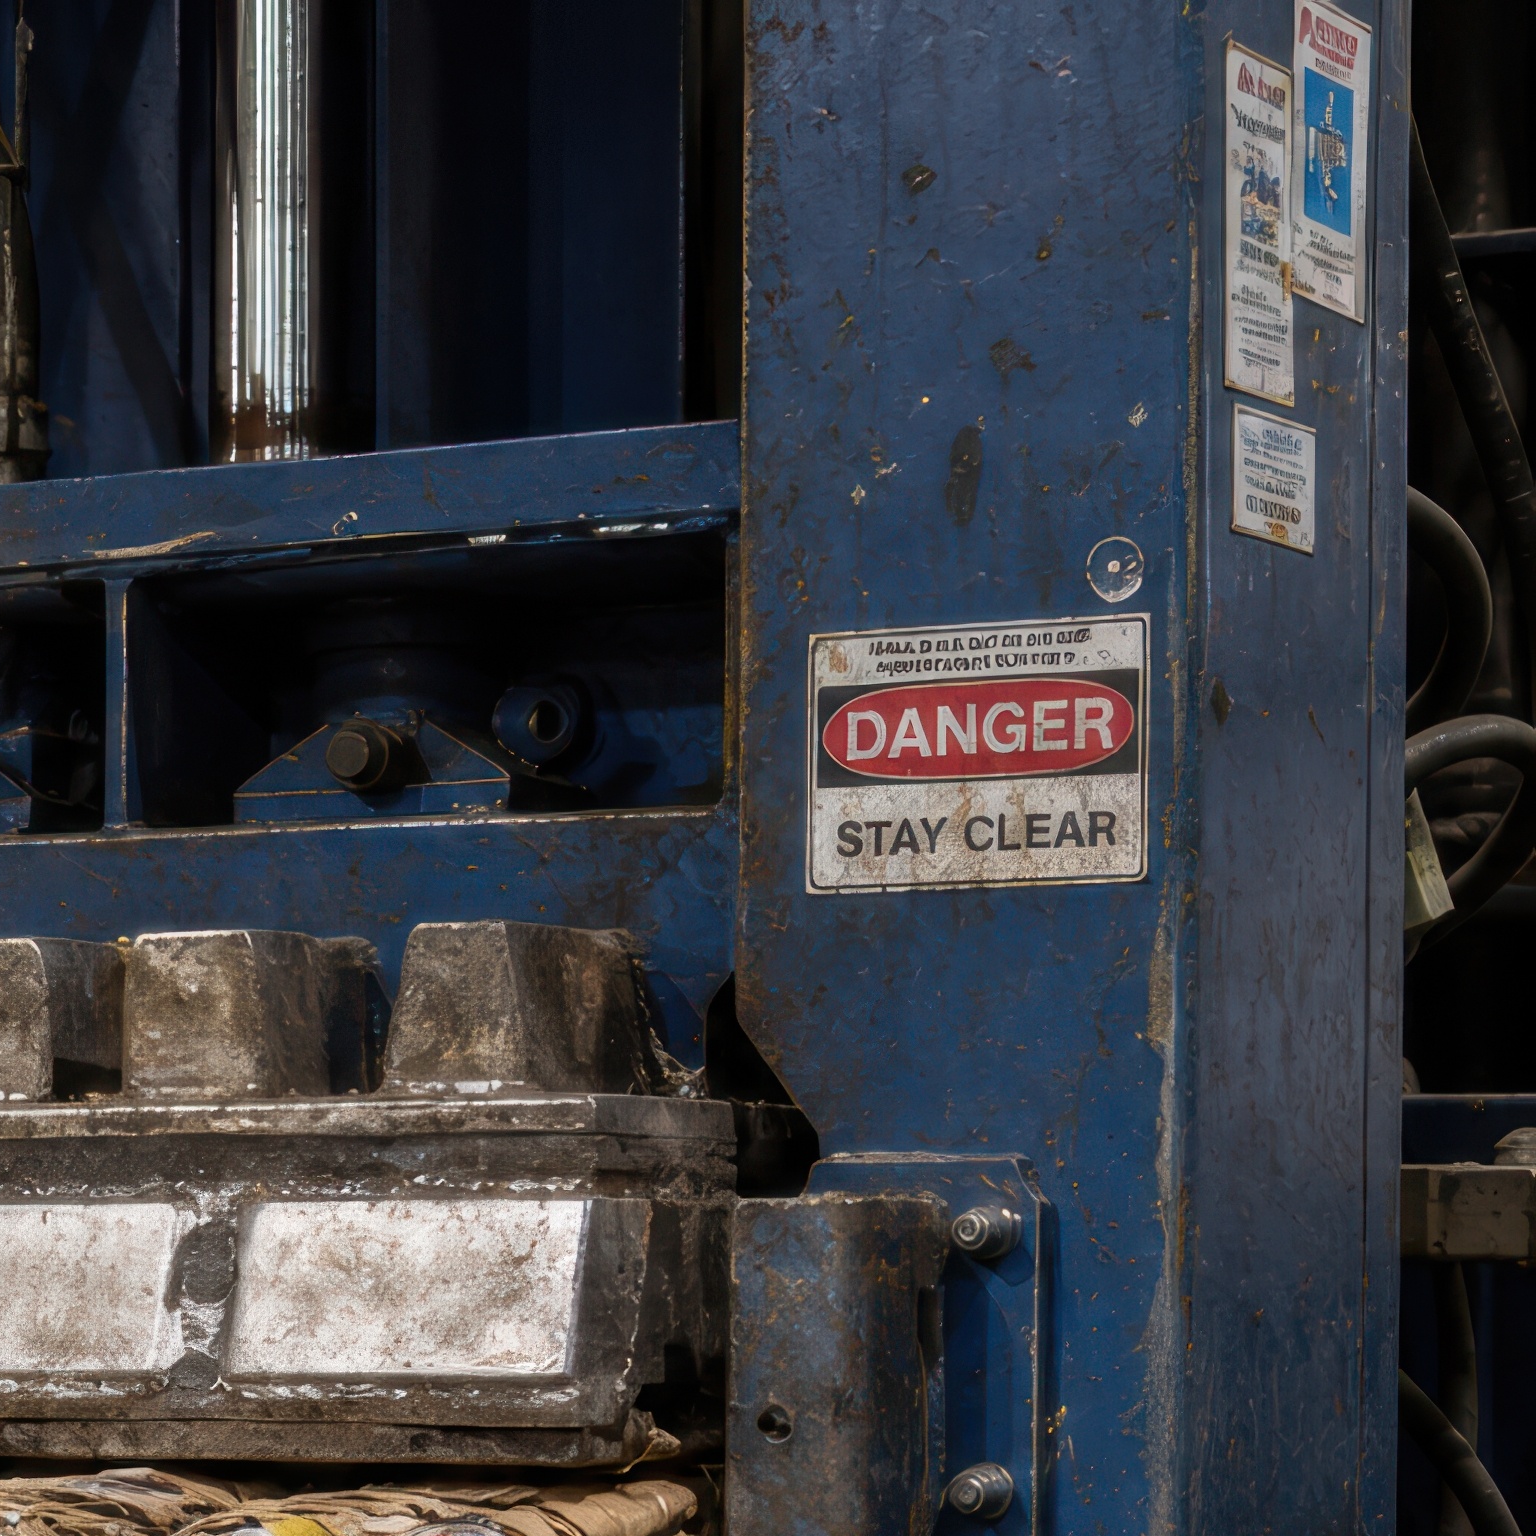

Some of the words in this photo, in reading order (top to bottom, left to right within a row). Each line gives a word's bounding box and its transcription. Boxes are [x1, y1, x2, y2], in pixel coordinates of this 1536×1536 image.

[846, 696, 1115, 762] DANGER
[836, 815, 948, 858] STAY
[964, 810, 1117, 852] CLEAR
